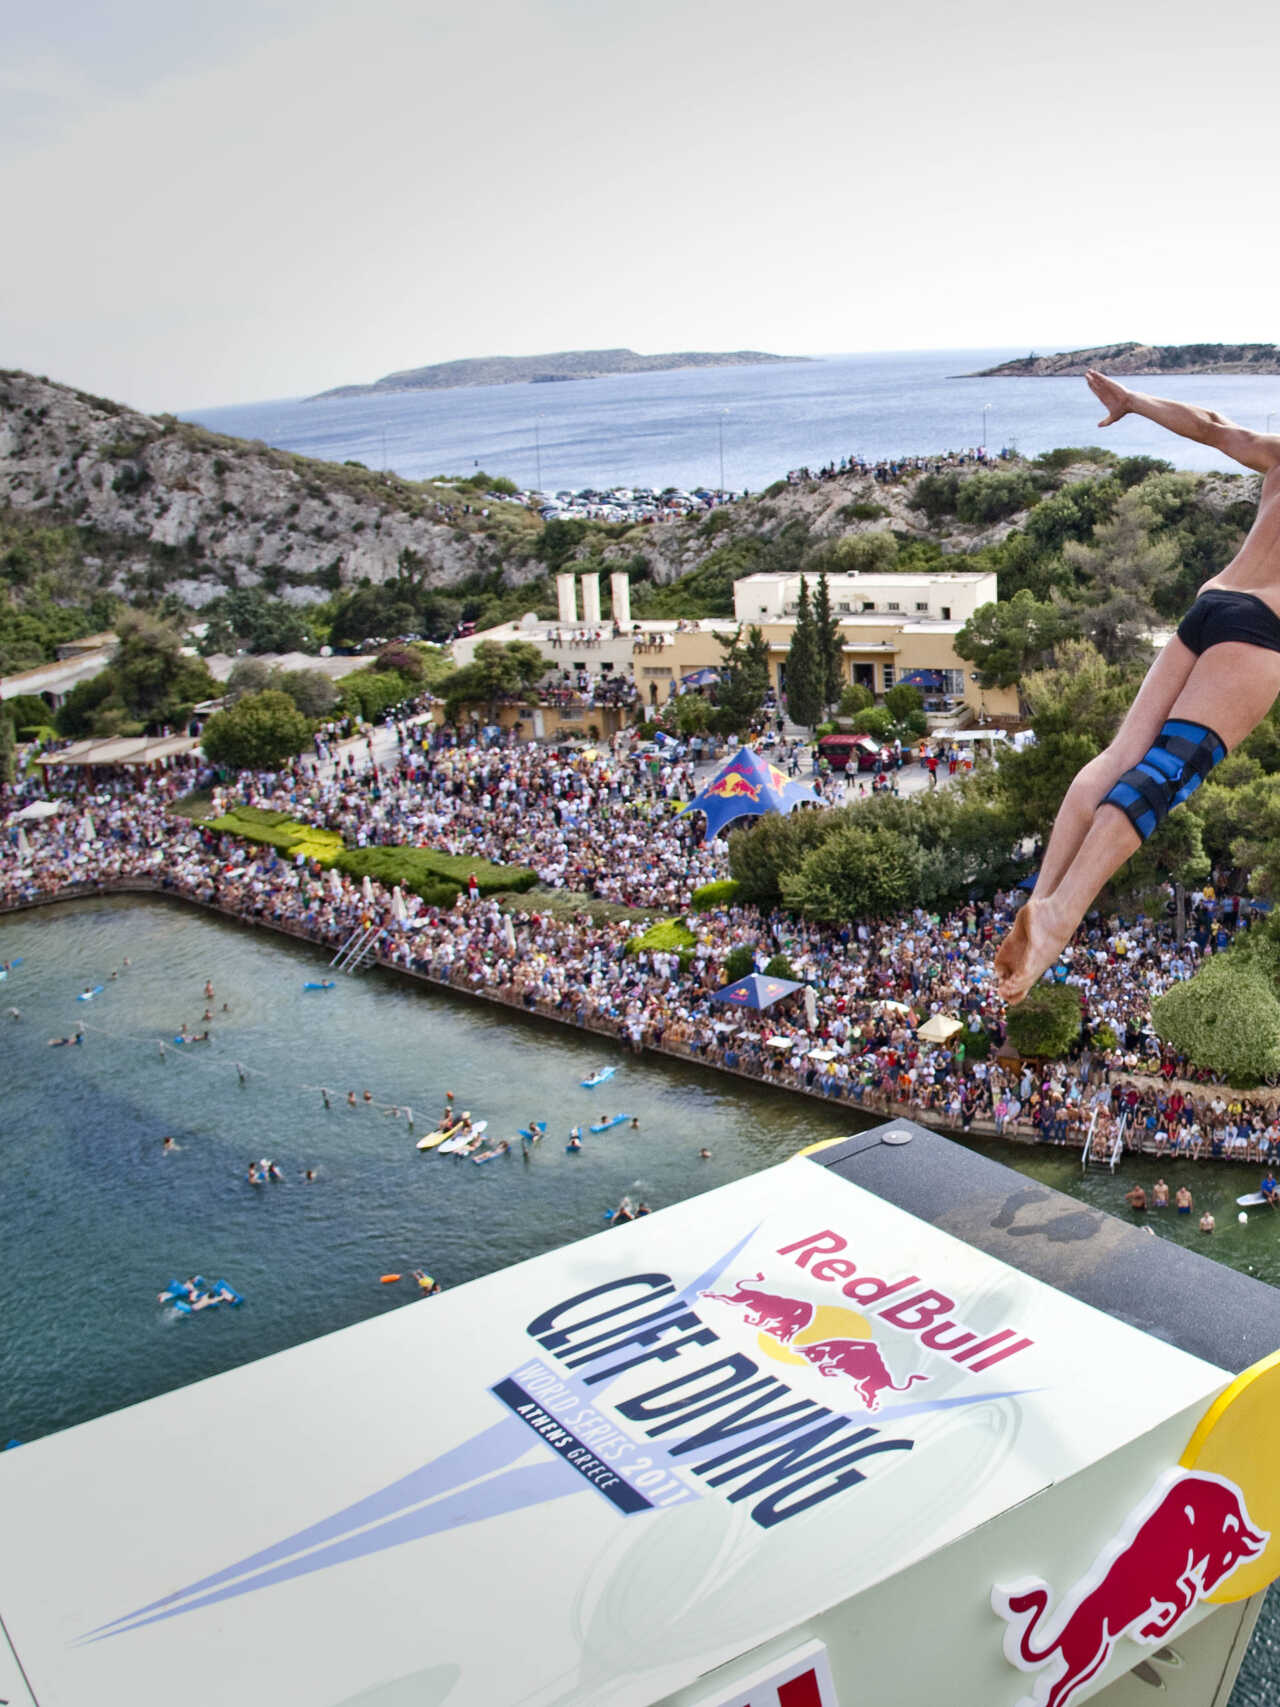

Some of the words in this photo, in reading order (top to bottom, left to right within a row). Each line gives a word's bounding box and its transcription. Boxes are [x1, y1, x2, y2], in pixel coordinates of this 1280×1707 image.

[526, 1272, 720, 1386] CLIFF
[776, 1230, 921, 1307] Red
[876, 1289, 1035, 1373] Bull
[514, 1362, 580, 1412] WORLD
[564, 1409, 637, 1460] SERIES
[619, 1457, 691, 1507] 2011
[516, 1403, 574, 1448] ATHENS
[566, 1448, 621, 1490] GREECE
[614, 1352, 915, 1529] DIVING
